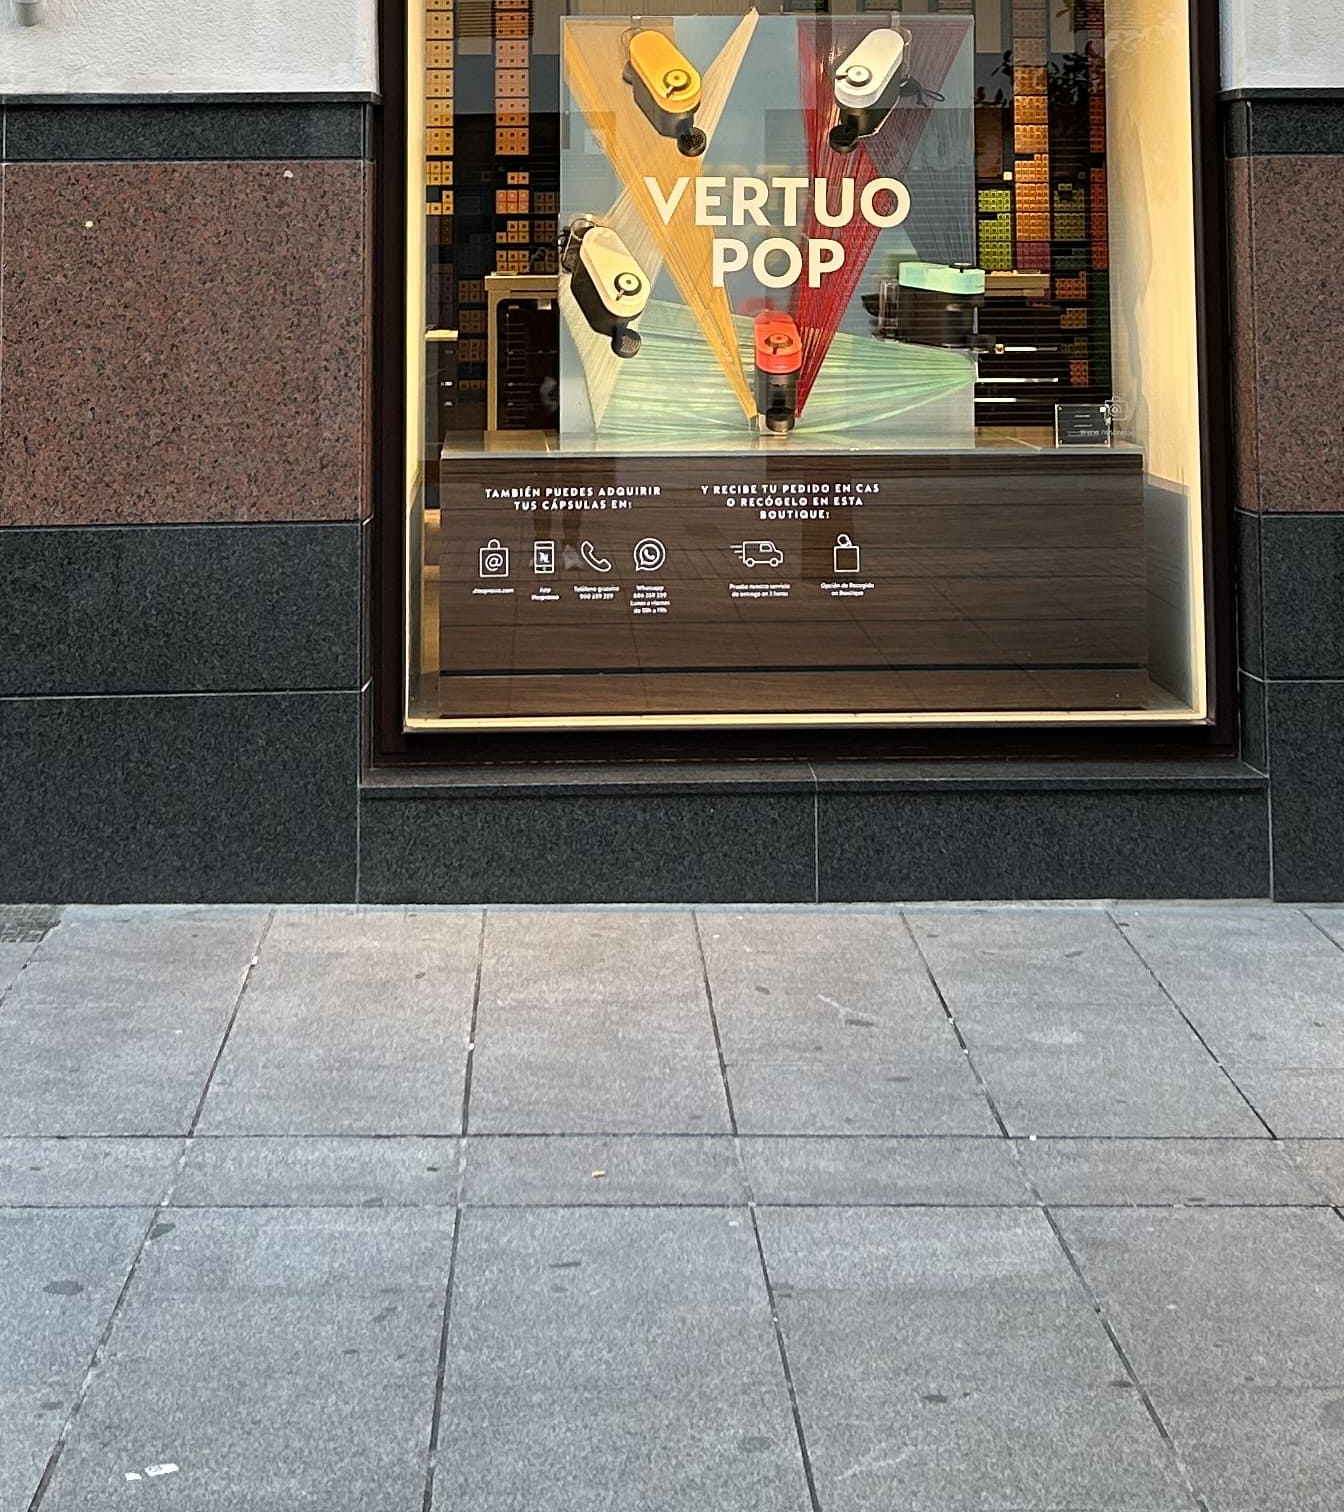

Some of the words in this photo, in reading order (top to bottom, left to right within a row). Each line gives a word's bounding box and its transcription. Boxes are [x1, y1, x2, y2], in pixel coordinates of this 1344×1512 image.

[644, 175, 912, 230] VERTUO
[712, 237, 847, 290] POP
[485, 485, 541, 499] TAMBIÉN
[545, 486, 594, 498] PUEDES
[598, 485, 662, 497] ADQUIRIR
[701, 485, 710, 495] Y
[713, 484, 758, 495] RECIBE
[761, 484, 777, 495] TU
[782, 483, 830, 494] PEDIDO
[834, 483, 851, 494] EN
[855, 483, 881, 493] CAS
[514, 500, 538, 511] TUS
[541, 498, 607, 511] CÁPSULAS
[726, 497, 736, 508] O
[740, 494, 809, 507] RECÓGELO
[812, 496, 829, 507] EN
[833, 496, 864, 506] ESTA
